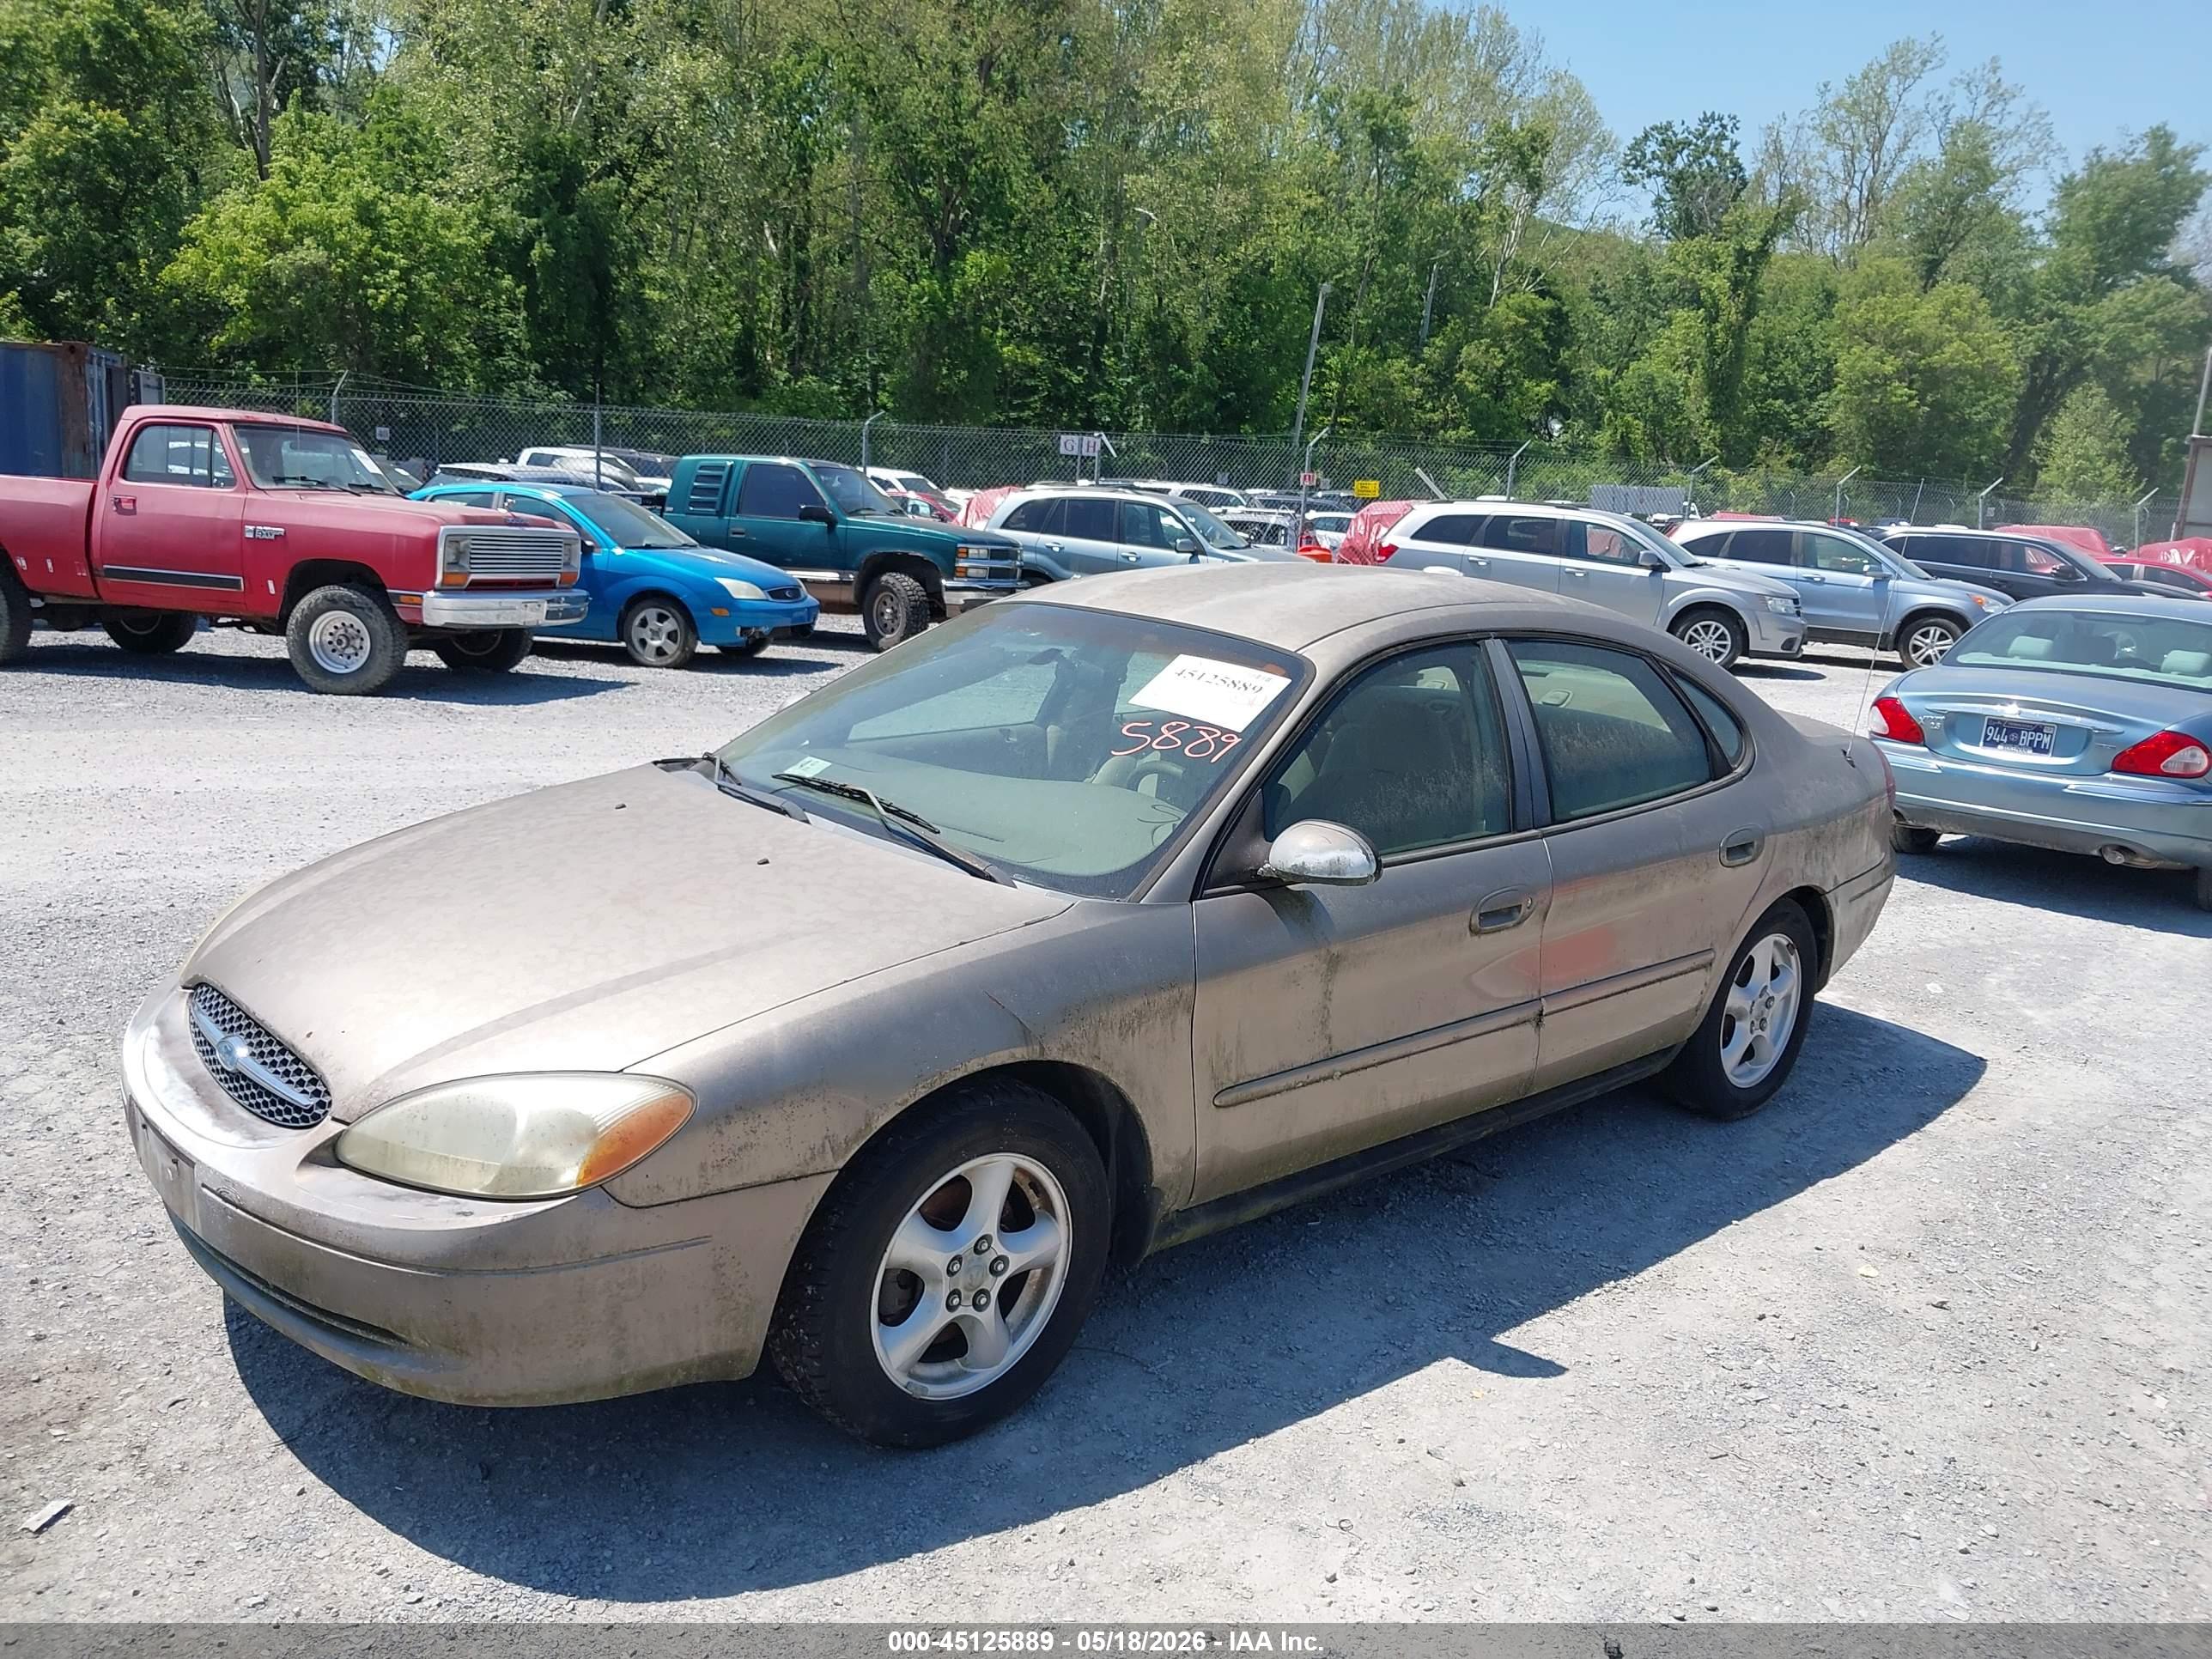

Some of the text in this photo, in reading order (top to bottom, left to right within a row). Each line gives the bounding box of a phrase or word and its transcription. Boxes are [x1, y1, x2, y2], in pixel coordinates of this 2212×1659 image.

[1064, 439, 1075, 452] G
[1086, 440, 1097, 453] H
[1174, 668, 1264, 694] 45125889
[1110, 720, 1243, 763] 5889
[1985, 726, 2008, 744] 944
[2019, 730, 2051, 750] BPPM
